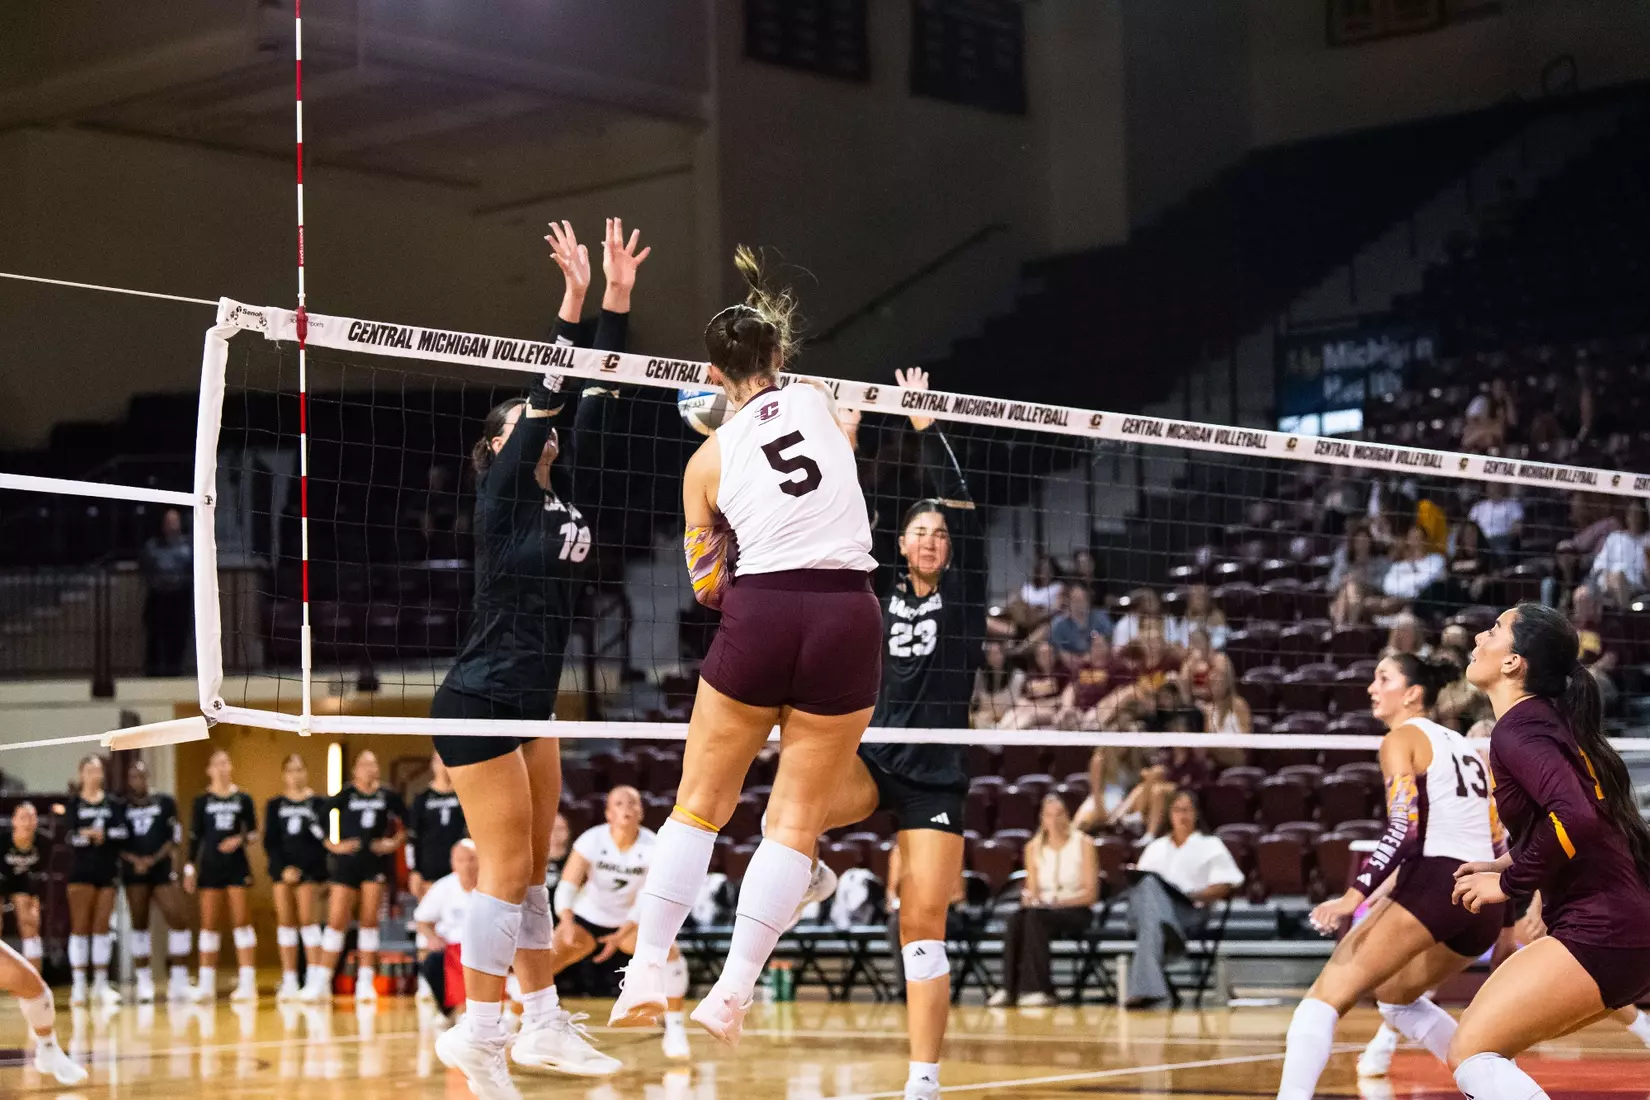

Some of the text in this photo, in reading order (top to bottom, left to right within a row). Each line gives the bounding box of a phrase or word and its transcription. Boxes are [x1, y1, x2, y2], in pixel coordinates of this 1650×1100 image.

[347, 321, 575, 368] CENTRAL MICHIGAN VOLLEYBALL
[645, 359, 701, 383] CENTRAL
[901, 390, 1068, 427] CENTRAL MICHIGAN VOLLEYBALL
[1121, 417, 1268, 449] CENTRAL MICHIGAN VOLLEYBALL
[1314, 440, 1351, 458] CENTRAL
[761, 430, 822, 497] 5
[888, 619, 937, 657] 23
[1452, 753, 1488, 798] 13
[612, 878, 628, 892] 7
